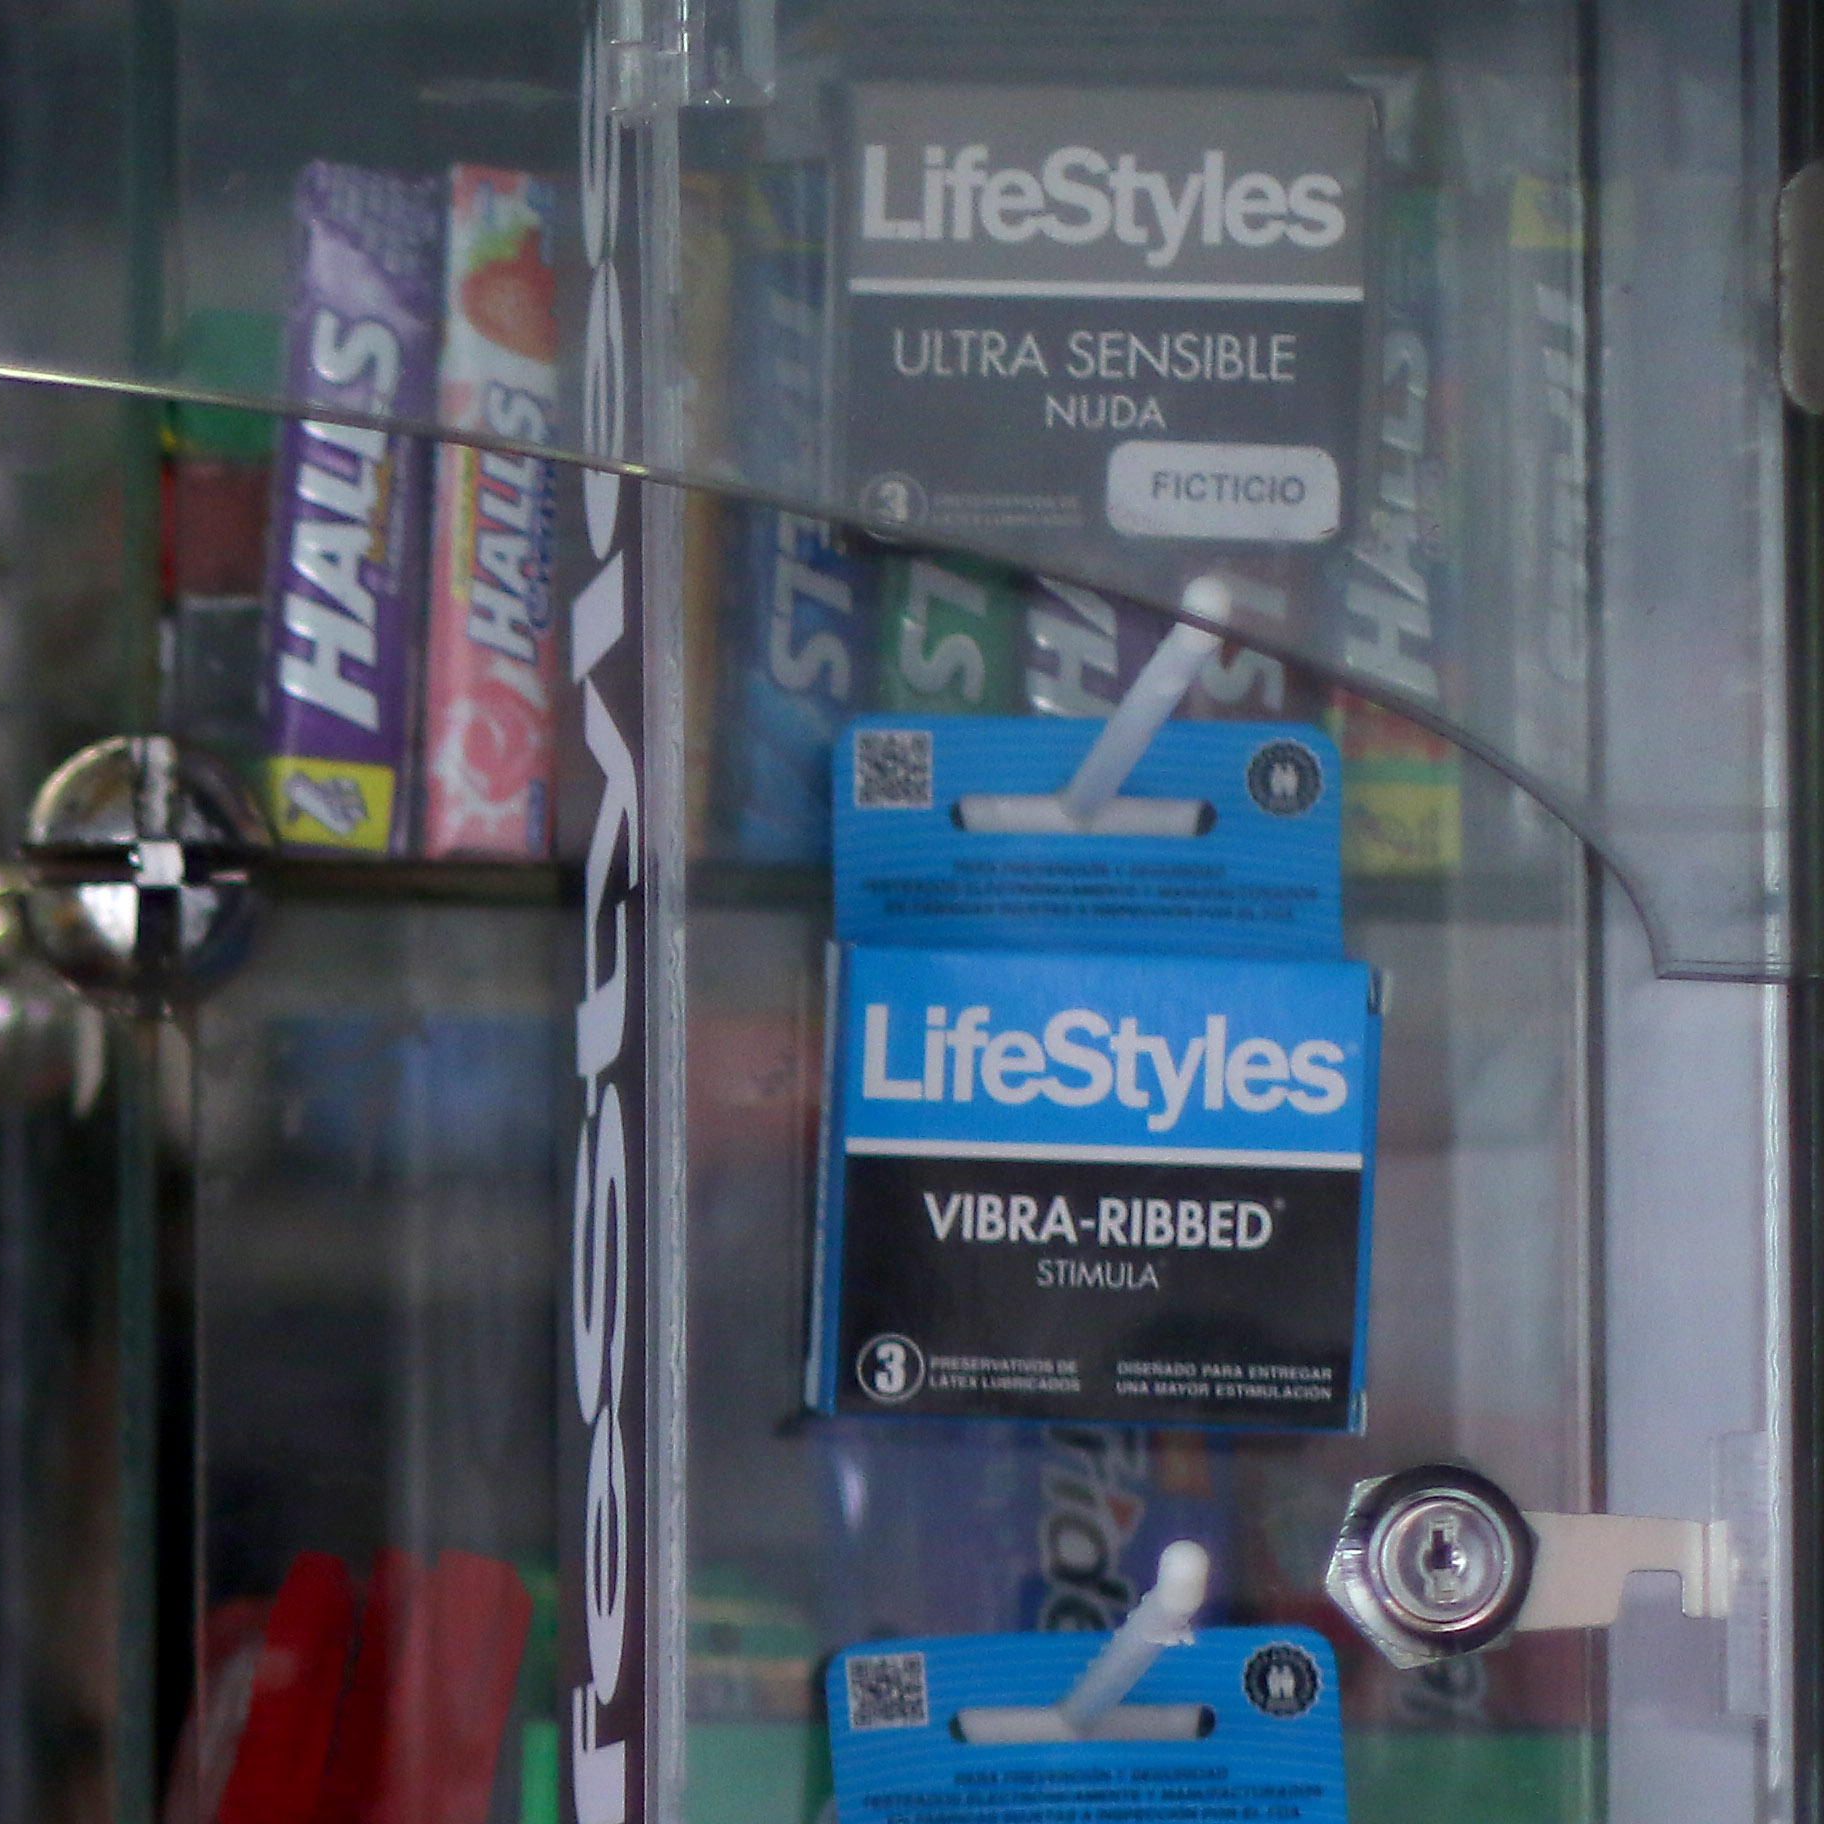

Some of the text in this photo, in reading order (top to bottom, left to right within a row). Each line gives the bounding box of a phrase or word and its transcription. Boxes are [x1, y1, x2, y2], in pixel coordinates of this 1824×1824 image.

[861, 144, 1348, 267] LifeStyles
[892, 327, 1299, 385] ULTRA SENSIBLE
[1043, 394, 1168, 431] NUDA
[1150, 469, 1307, 507] FICTICIO
[862, 1003, 1348, 1131] LifeStyles
[923, 1191, 1274, 1251] VIBRA-RIBBED
[1035, 1257, 1160, 1290] STIMULA
[874, 1340, 907, 1394] 3
